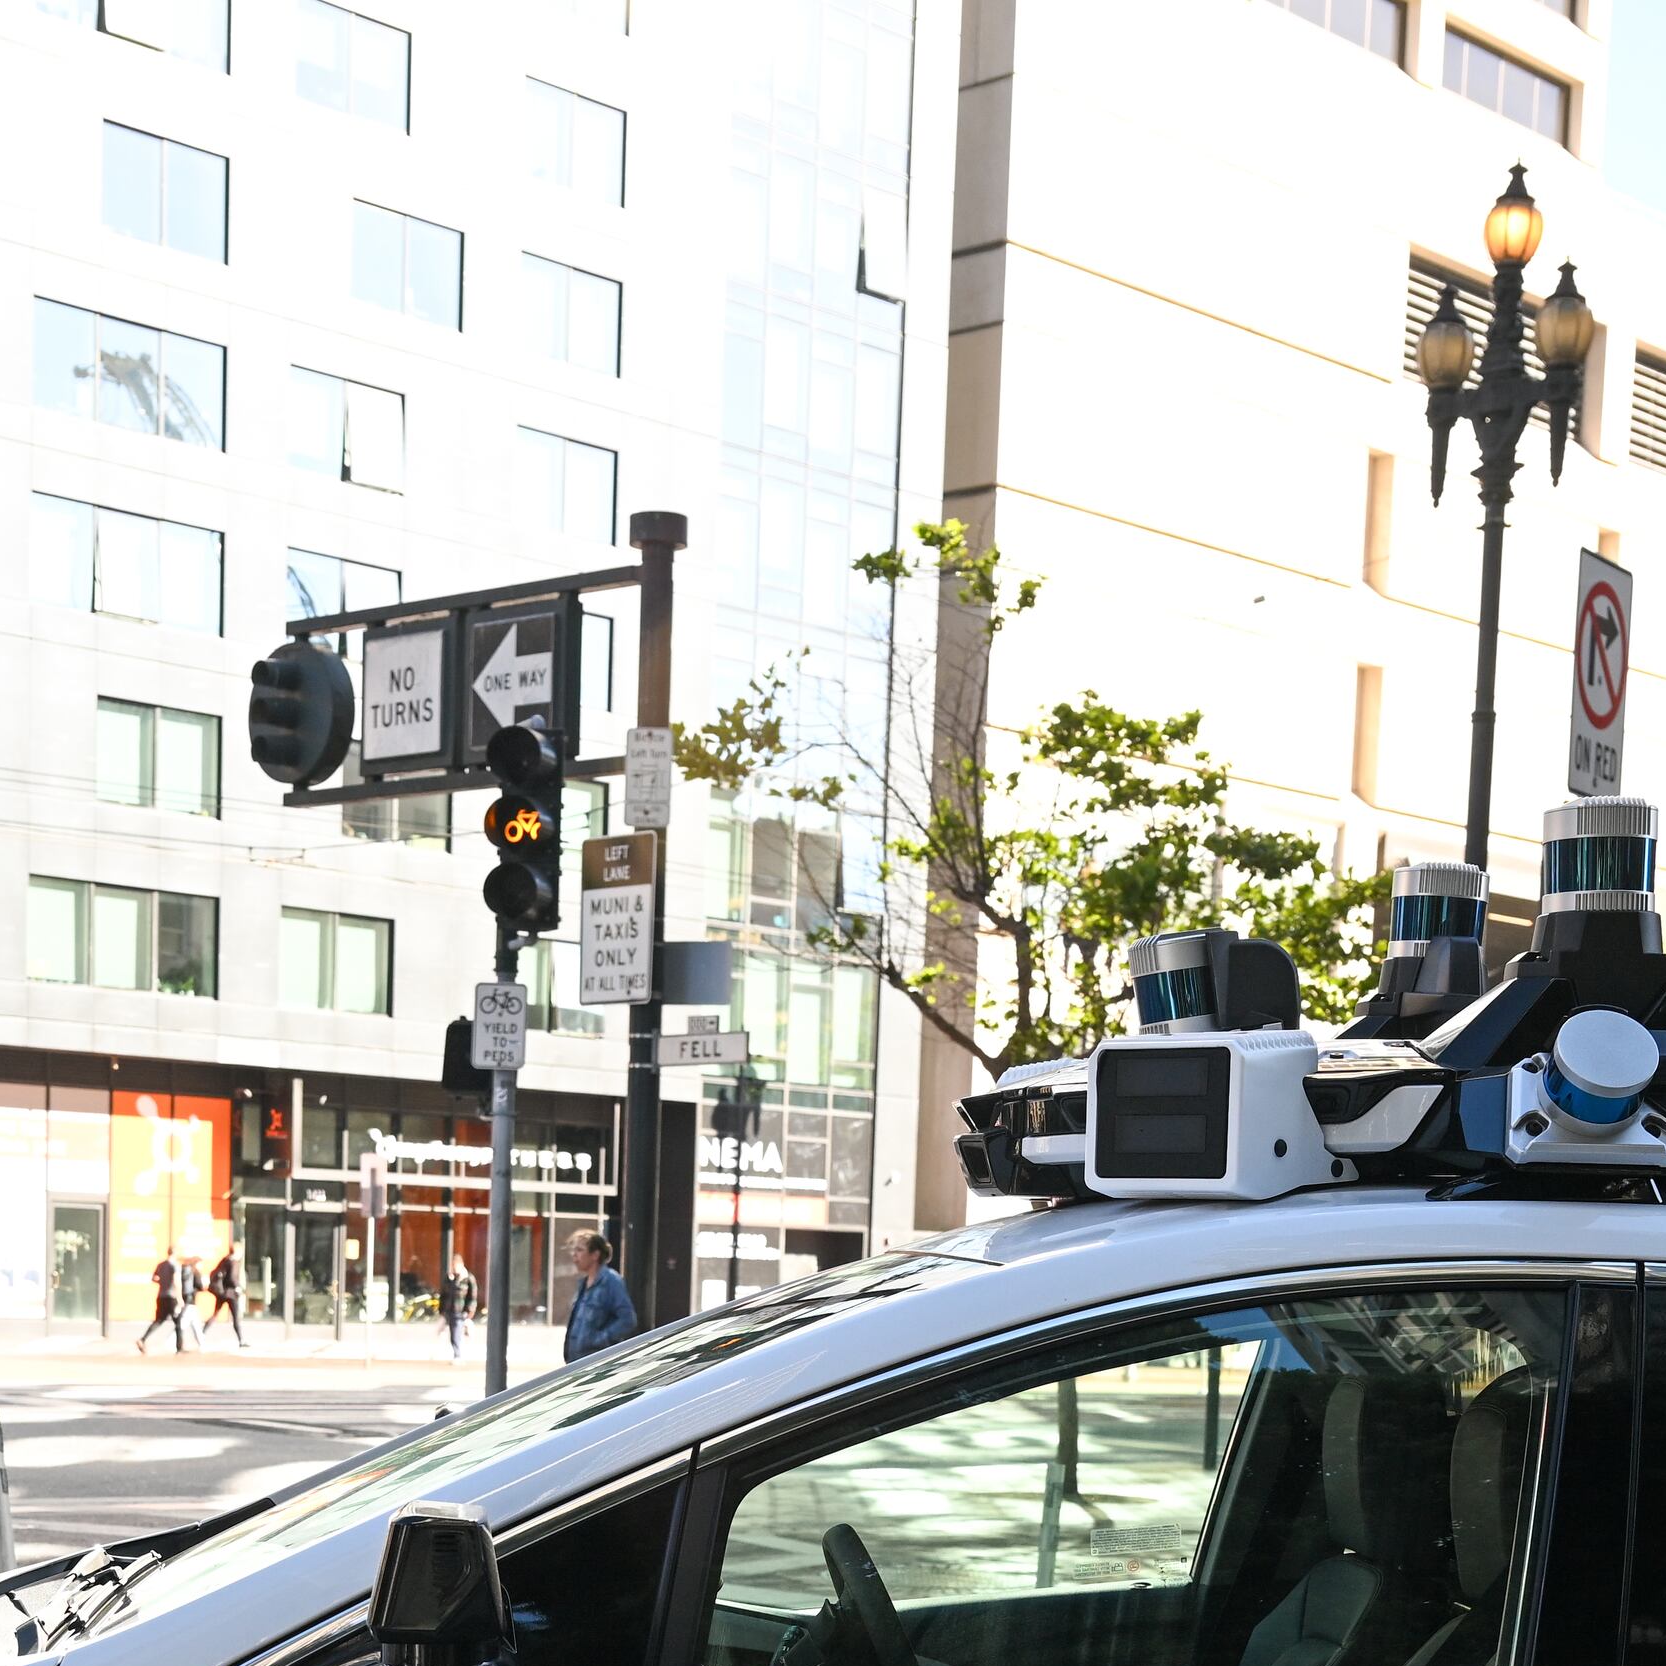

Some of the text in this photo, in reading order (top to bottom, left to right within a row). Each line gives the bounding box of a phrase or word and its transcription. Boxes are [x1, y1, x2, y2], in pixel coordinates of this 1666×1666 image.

[389, 666, 416, 693] NO
[484, 668, 547, 692] ONE WAY
[371, 697, 434, 729] TURNS
[1575, 734, 1618, 782] ON RED
[604, 845, 629, 862] LEFT
[602, 864, 631, 881] LANE
[590, 894, 644, 916] MUNI &
[594, 920, 639, 941] TAXIS
[594, 948, 638, 968] ONLY
[584, 972, 647, 992] AT ALL TIMES
[483, 1022, 519, 1035] YIELD
[493, 1036, 508, 1048] TO
[679, 1040, 722, 1059] FELL
[484, 1050, 515, 1063] PEDS
[698, 1135, 784, 1173] NEMA
